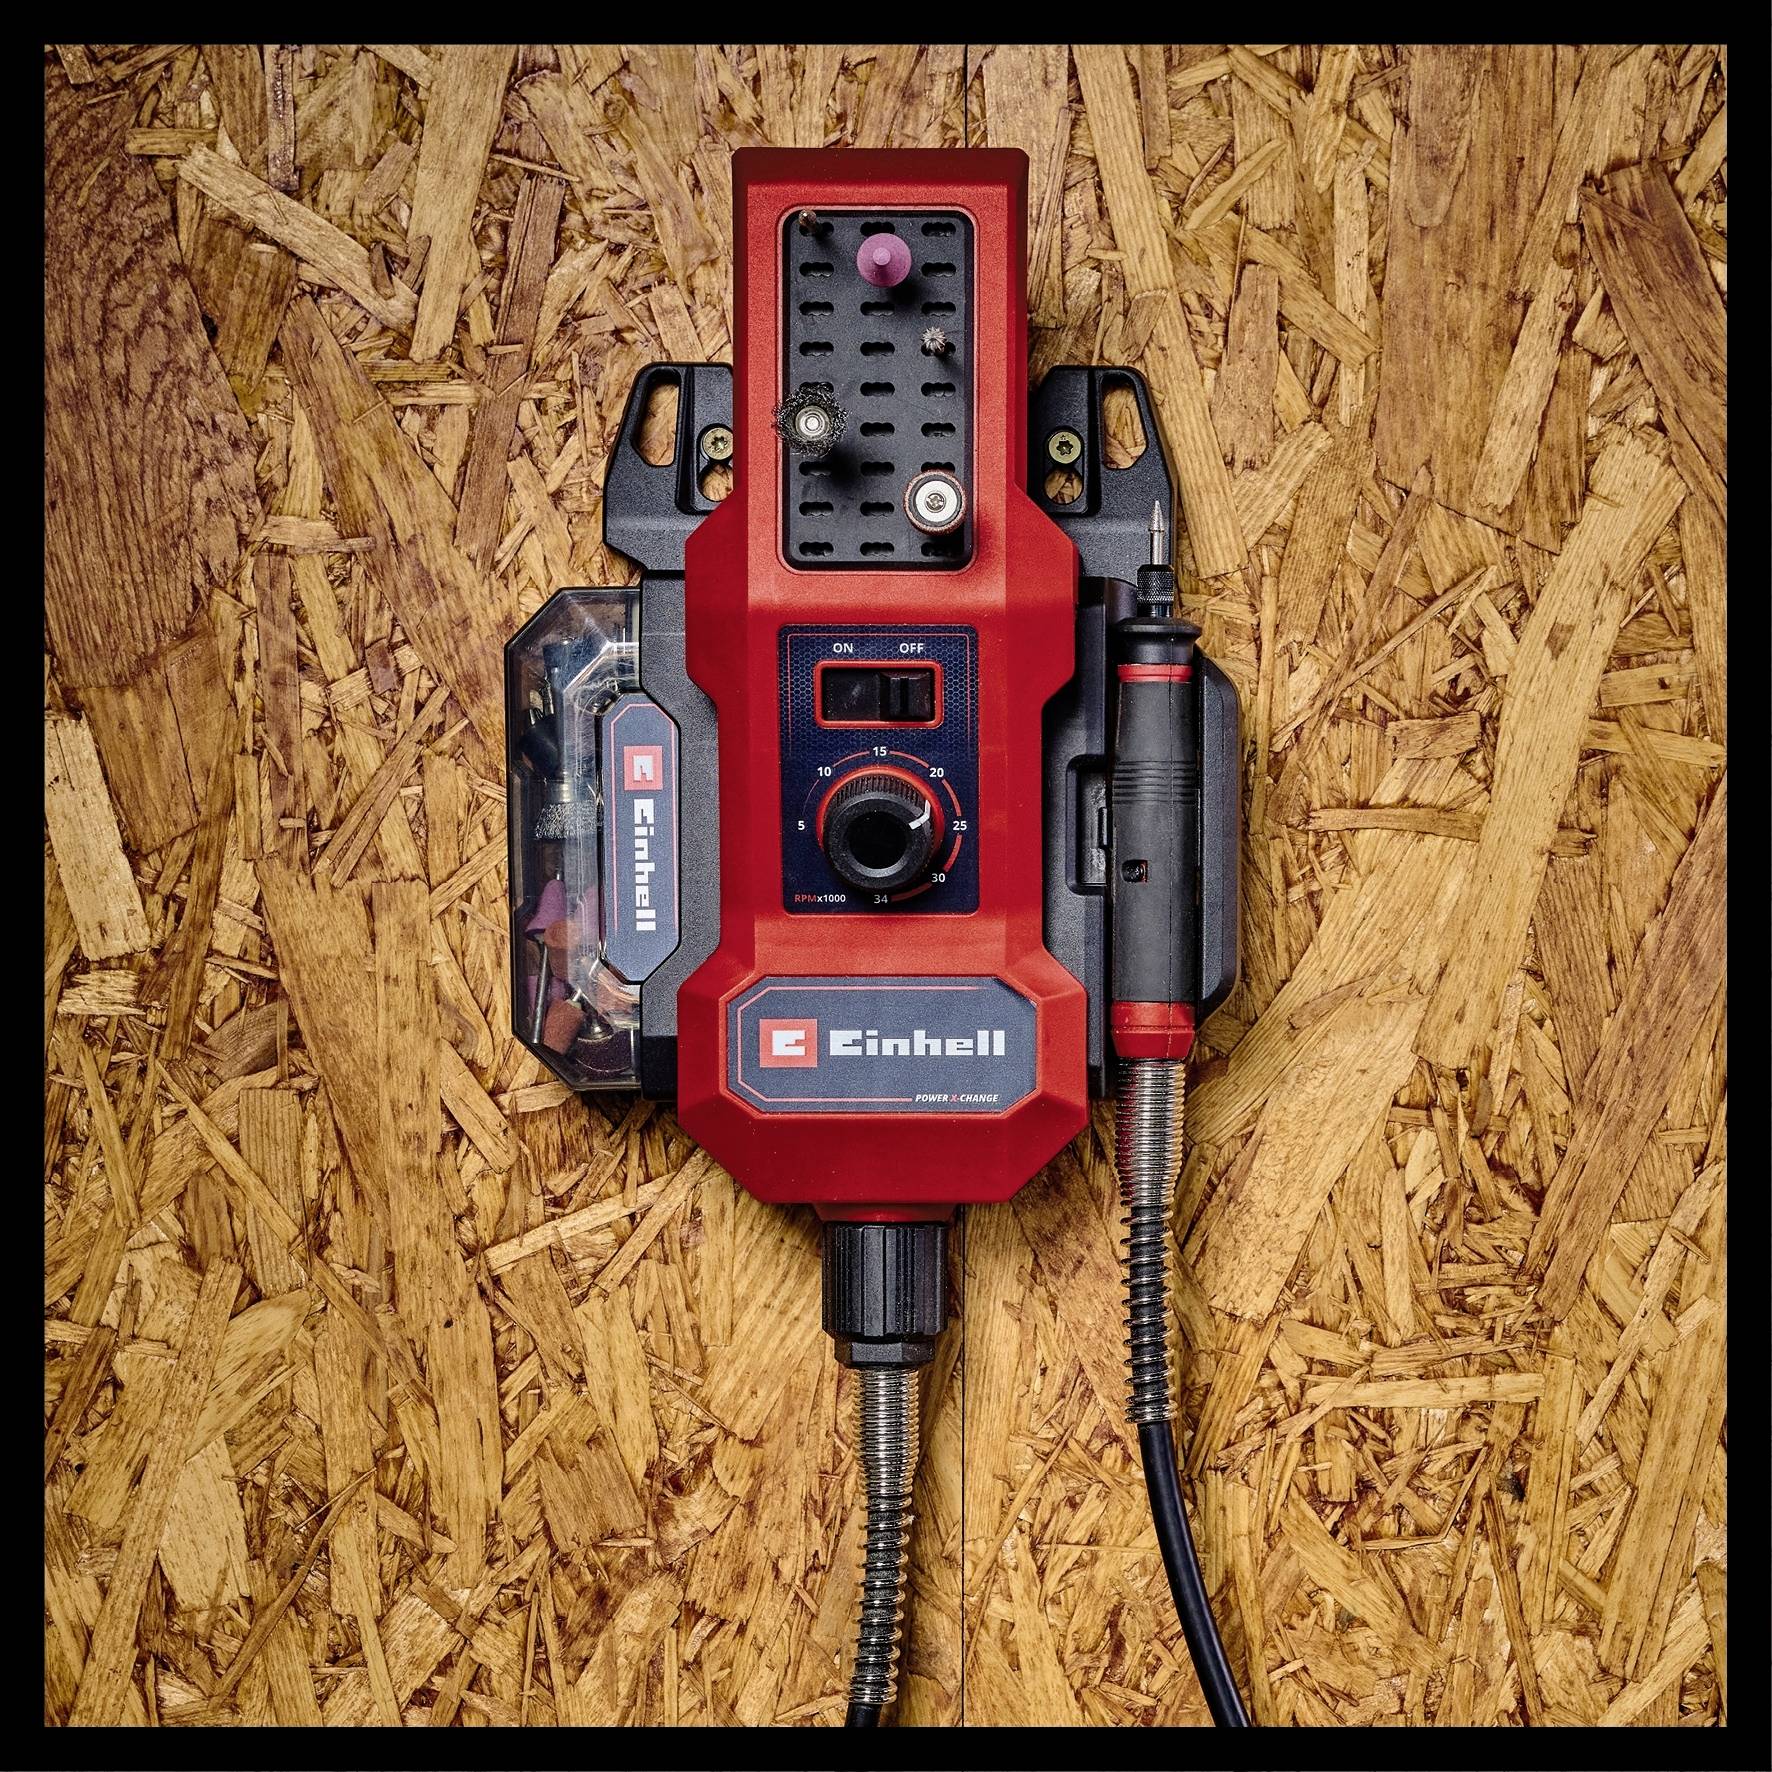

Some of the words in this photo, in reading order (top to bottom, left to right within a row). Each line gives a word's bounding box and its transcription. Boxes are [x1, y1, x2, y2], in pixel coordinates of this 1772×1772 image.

[832, 642, 853, 654] ON
[899, 642, 924, 654] OFF
[872, 746, 887, 757] 15
[817, 766, 832, 777] 10
[929, 767, 944, 778] 20
[797, 820, 805, 830] 5
[952, 820, 967, 830] 25
[633, 798, 656, 931] Einhell
[931, 873, 946, 883] 30
[873, 894, 888, 904] 34
[829, 1029, 1006, 1056] Einhell
[915, 1093, 949, 1103] POWER
[949, 1093, 1000, 1103] X-CHANGE
